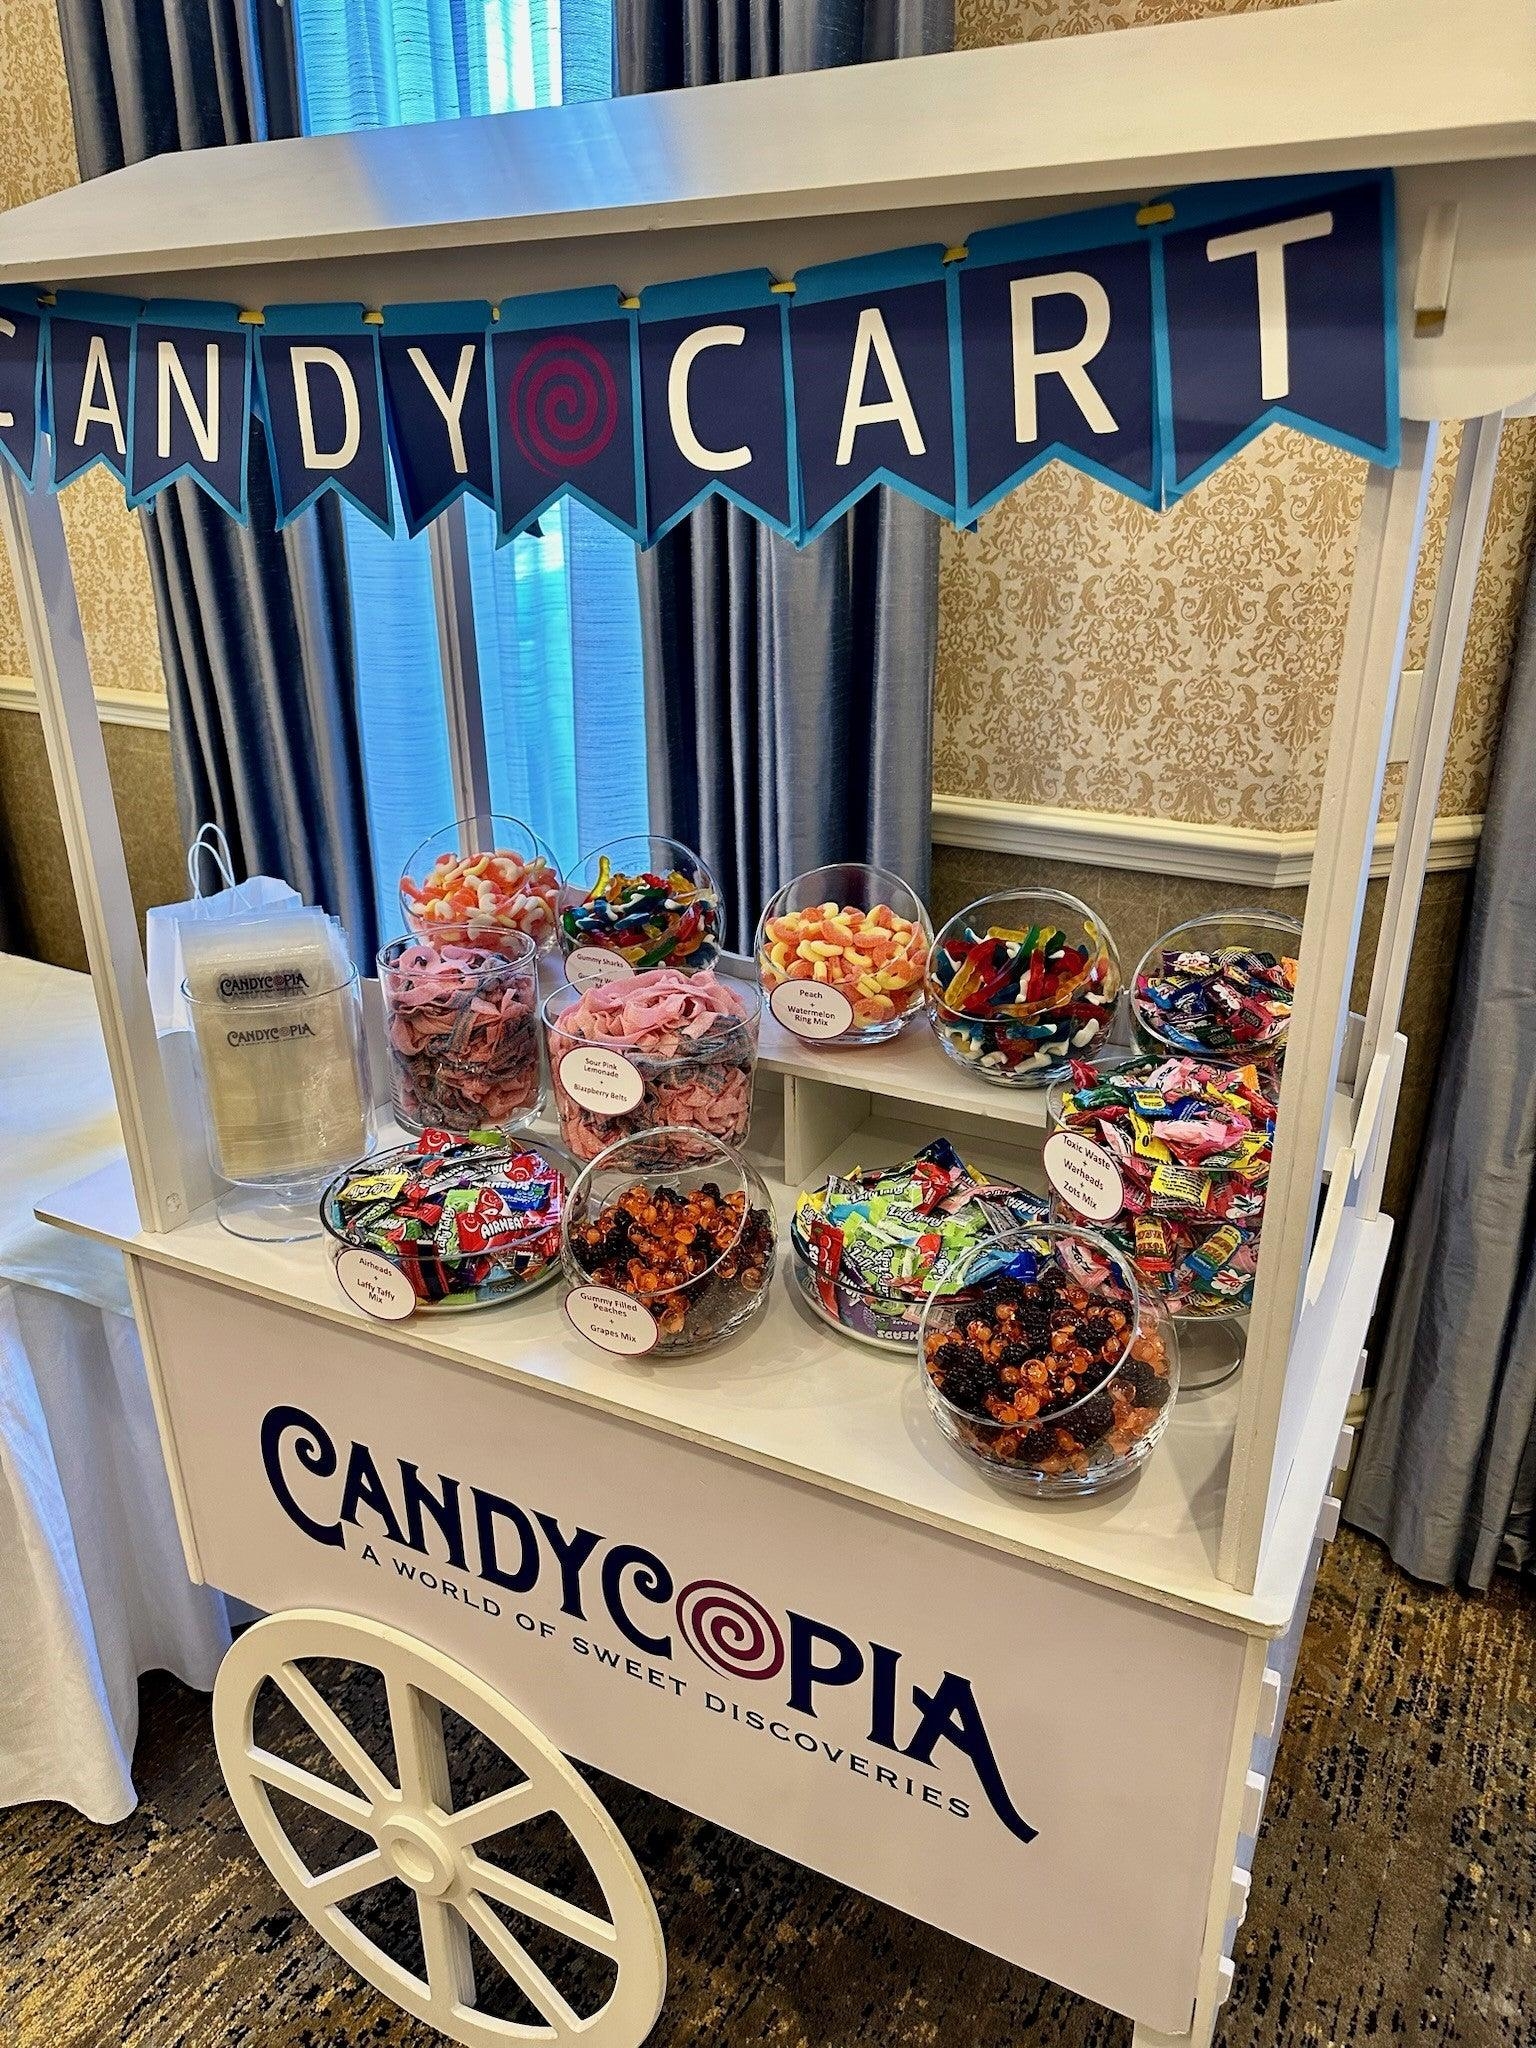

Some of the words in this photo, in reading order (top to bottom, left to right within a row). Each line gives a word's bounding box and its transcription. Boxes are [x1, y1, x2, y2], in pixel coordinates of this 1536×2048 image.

[0, 317, 475, 473] ANDY
[668, 211, 1333, 471] CART
[577, 953, 602, 964] Gummy
[602, 959, 624, 968] Sharks
[220, 973, 309, 996] CANDYCOPIA
[799, 989, 823, 999] Peach
[787, 1005, 836, 1020] Watermelon
[794, 1014, 812, 1025] Ring
[813, 1018, 828, 1026] Mix
[227, 1023, 316, 1047] CANDYCOPIA
[583, 1065, 619, 1079] Lemonade
[585, 1057, 601, 1067] Sour
[602, 1061, 618, 1071] Pink
[610, 1092, 628, 1102] Belts
[1062, 1134, 1083, 1154] Toxic
[1085, 1147, 1111, 1171] Waste
[1063, 1158, 1104, 1191] Warheads
[1063, 1180, 1081, 1199] Zots
[1082, 1193, 1097, 1209] Mix
[481, 1216, 525, 1240] AIRHEA
[358, 1257, 393, 1277] Airheads
[357, 1278, 376, 1292] Laffy
[376, 1286, 395, 1301] Taffy
[368, 1292, 383, 1304] Mix
[580, 1292, 613, 1307] Gummy
[614, 1300, 638, 1312] Filled
[593, 1303, 628, 1317] Peaches
[590, 1324, 619, 1338] Grapes
[620, 1332, 637, 1343] Mix
[260, 1405, 1039, 1845] CANDYCOPIA
[361, 1544, 382, 1567] A
[391, 1557, 501, 1617] WORLD
[515, 1613, 556, 1639] OF
[572, 1636, 687, 1697] SWEET
[704, 1691, 970, 1819] DISCOVERIES
